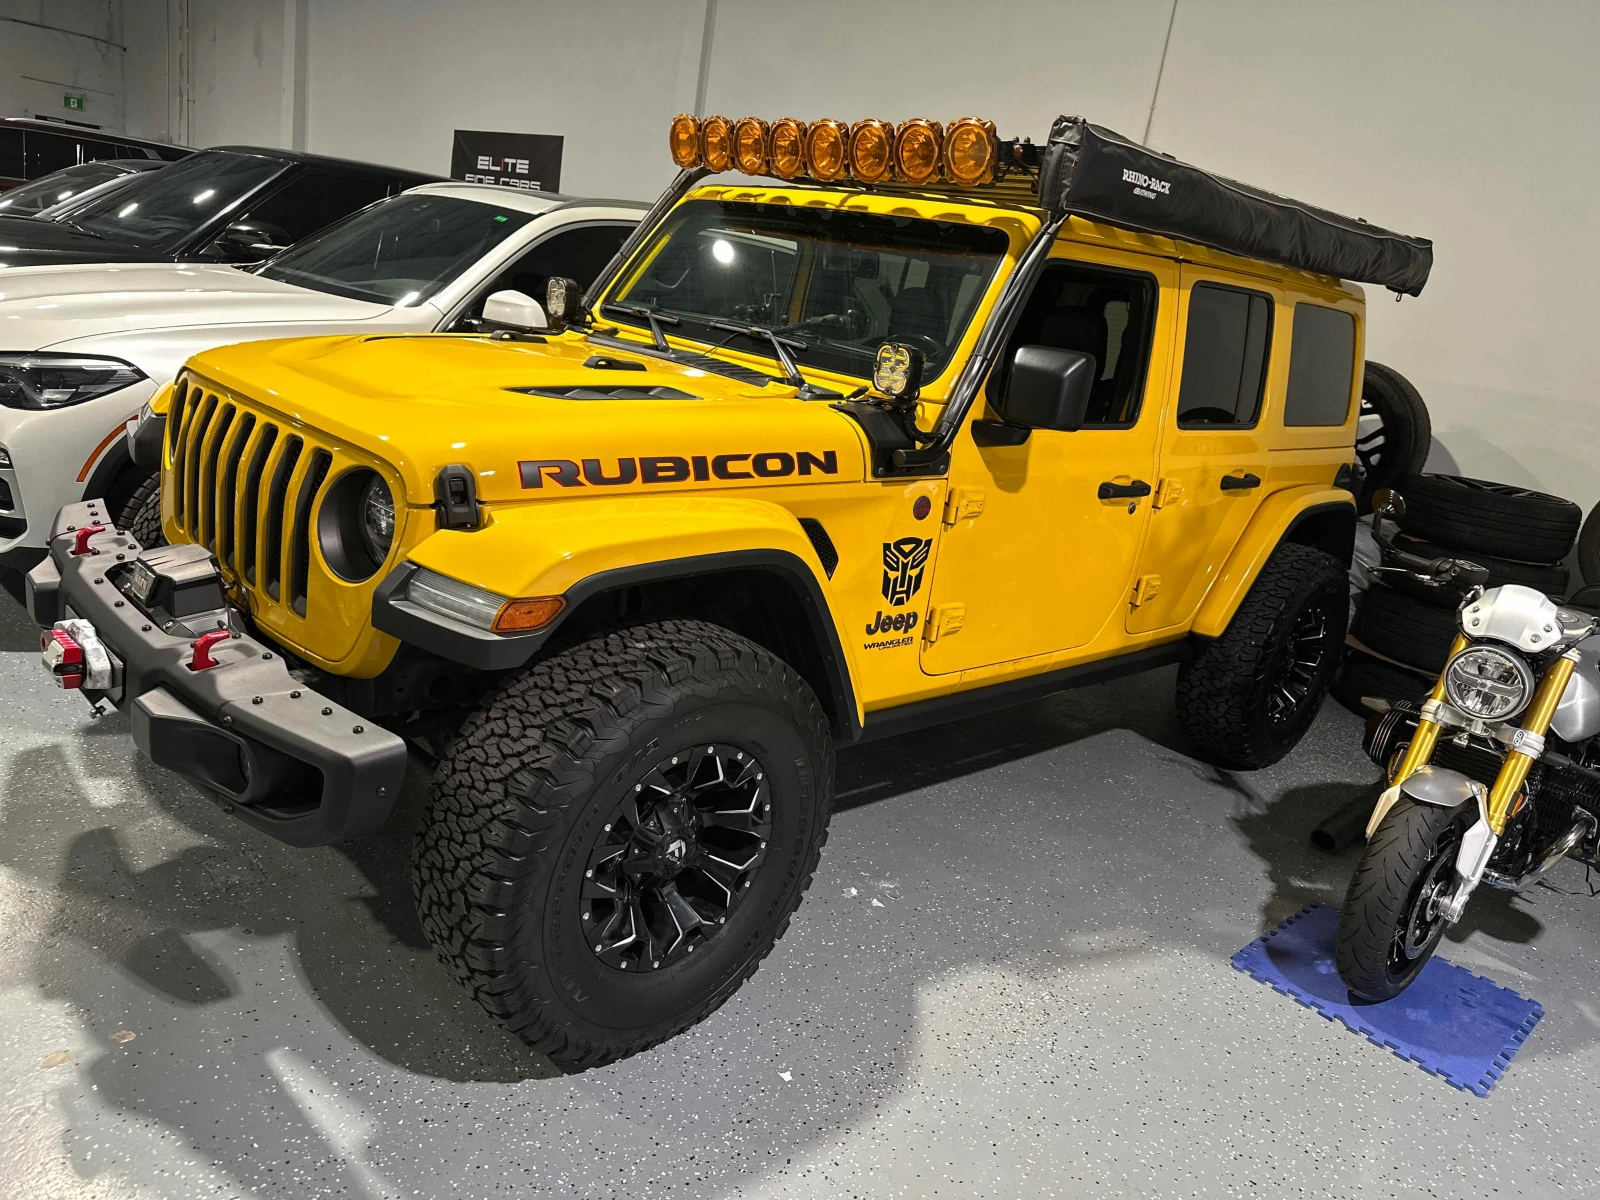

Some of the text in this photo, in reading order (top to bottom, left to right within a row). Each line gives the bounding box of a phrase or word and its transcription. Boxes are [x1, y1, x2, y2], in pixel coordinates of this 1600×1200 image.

[477, 155, 529, 173] ELITE
[1122, 168, 1171, 195] RHINO-RACK
[517, 450, 838, 489] RUBICON
[865, 610, 918, 636] Jeep
[863, 637, 913, 650] WRANGLER
